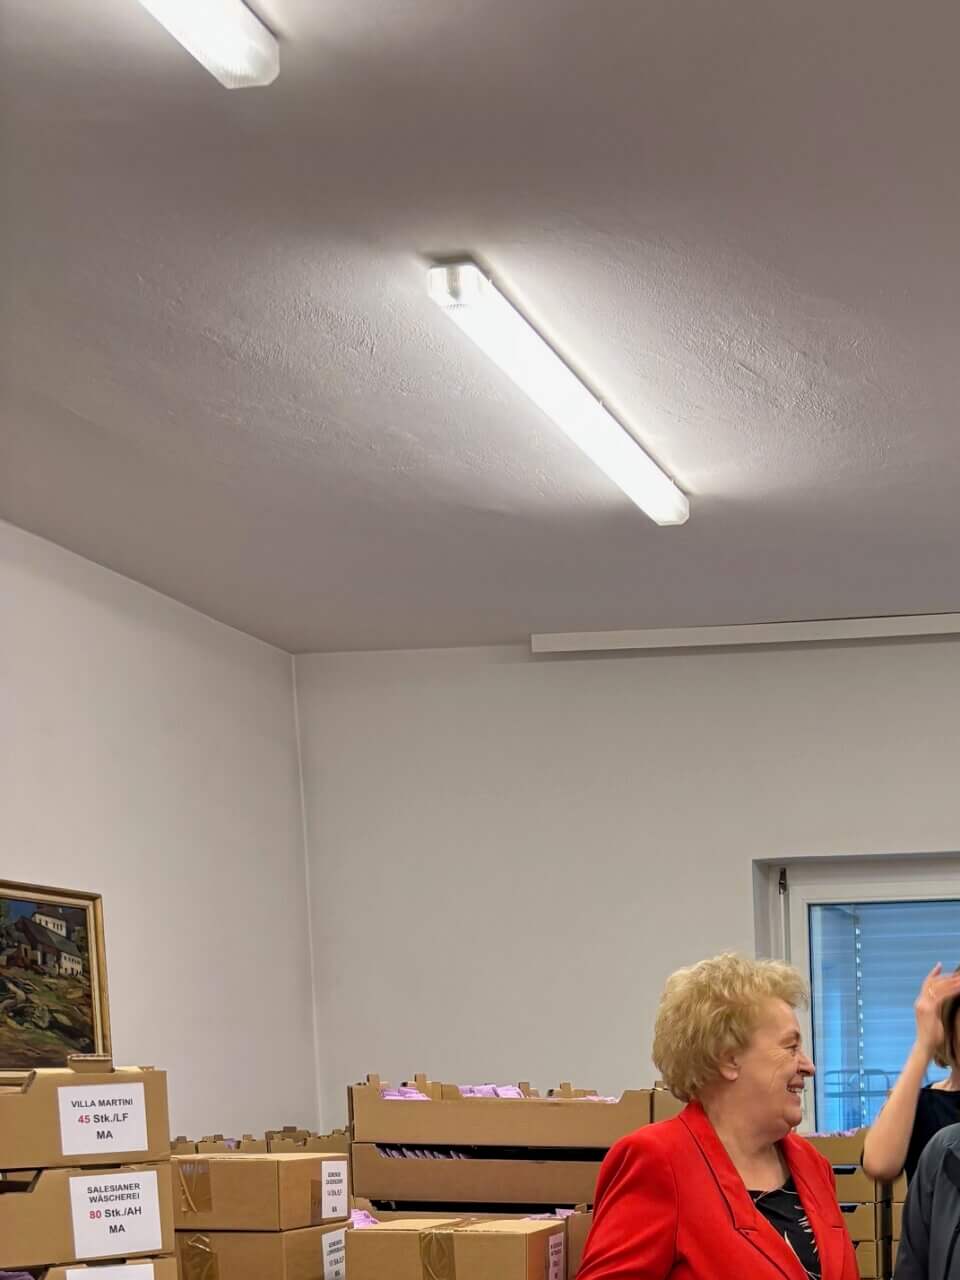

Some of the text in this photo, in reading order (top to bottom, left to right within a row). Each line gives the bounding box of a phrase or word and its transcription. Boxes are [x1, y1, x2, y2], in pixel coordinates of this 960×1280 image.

[71, 1098, 133, 1108] VILLA MARTINI
[78, 1112, 128, 1124] 45 Stk./LF
[96, 1130, 113, 1139] MA
[87, 1183, 140, 1194] SALESIANER
[104, 1206, 142, 1218] Stk./AH
[109, 1224, 126, 1234] MA
